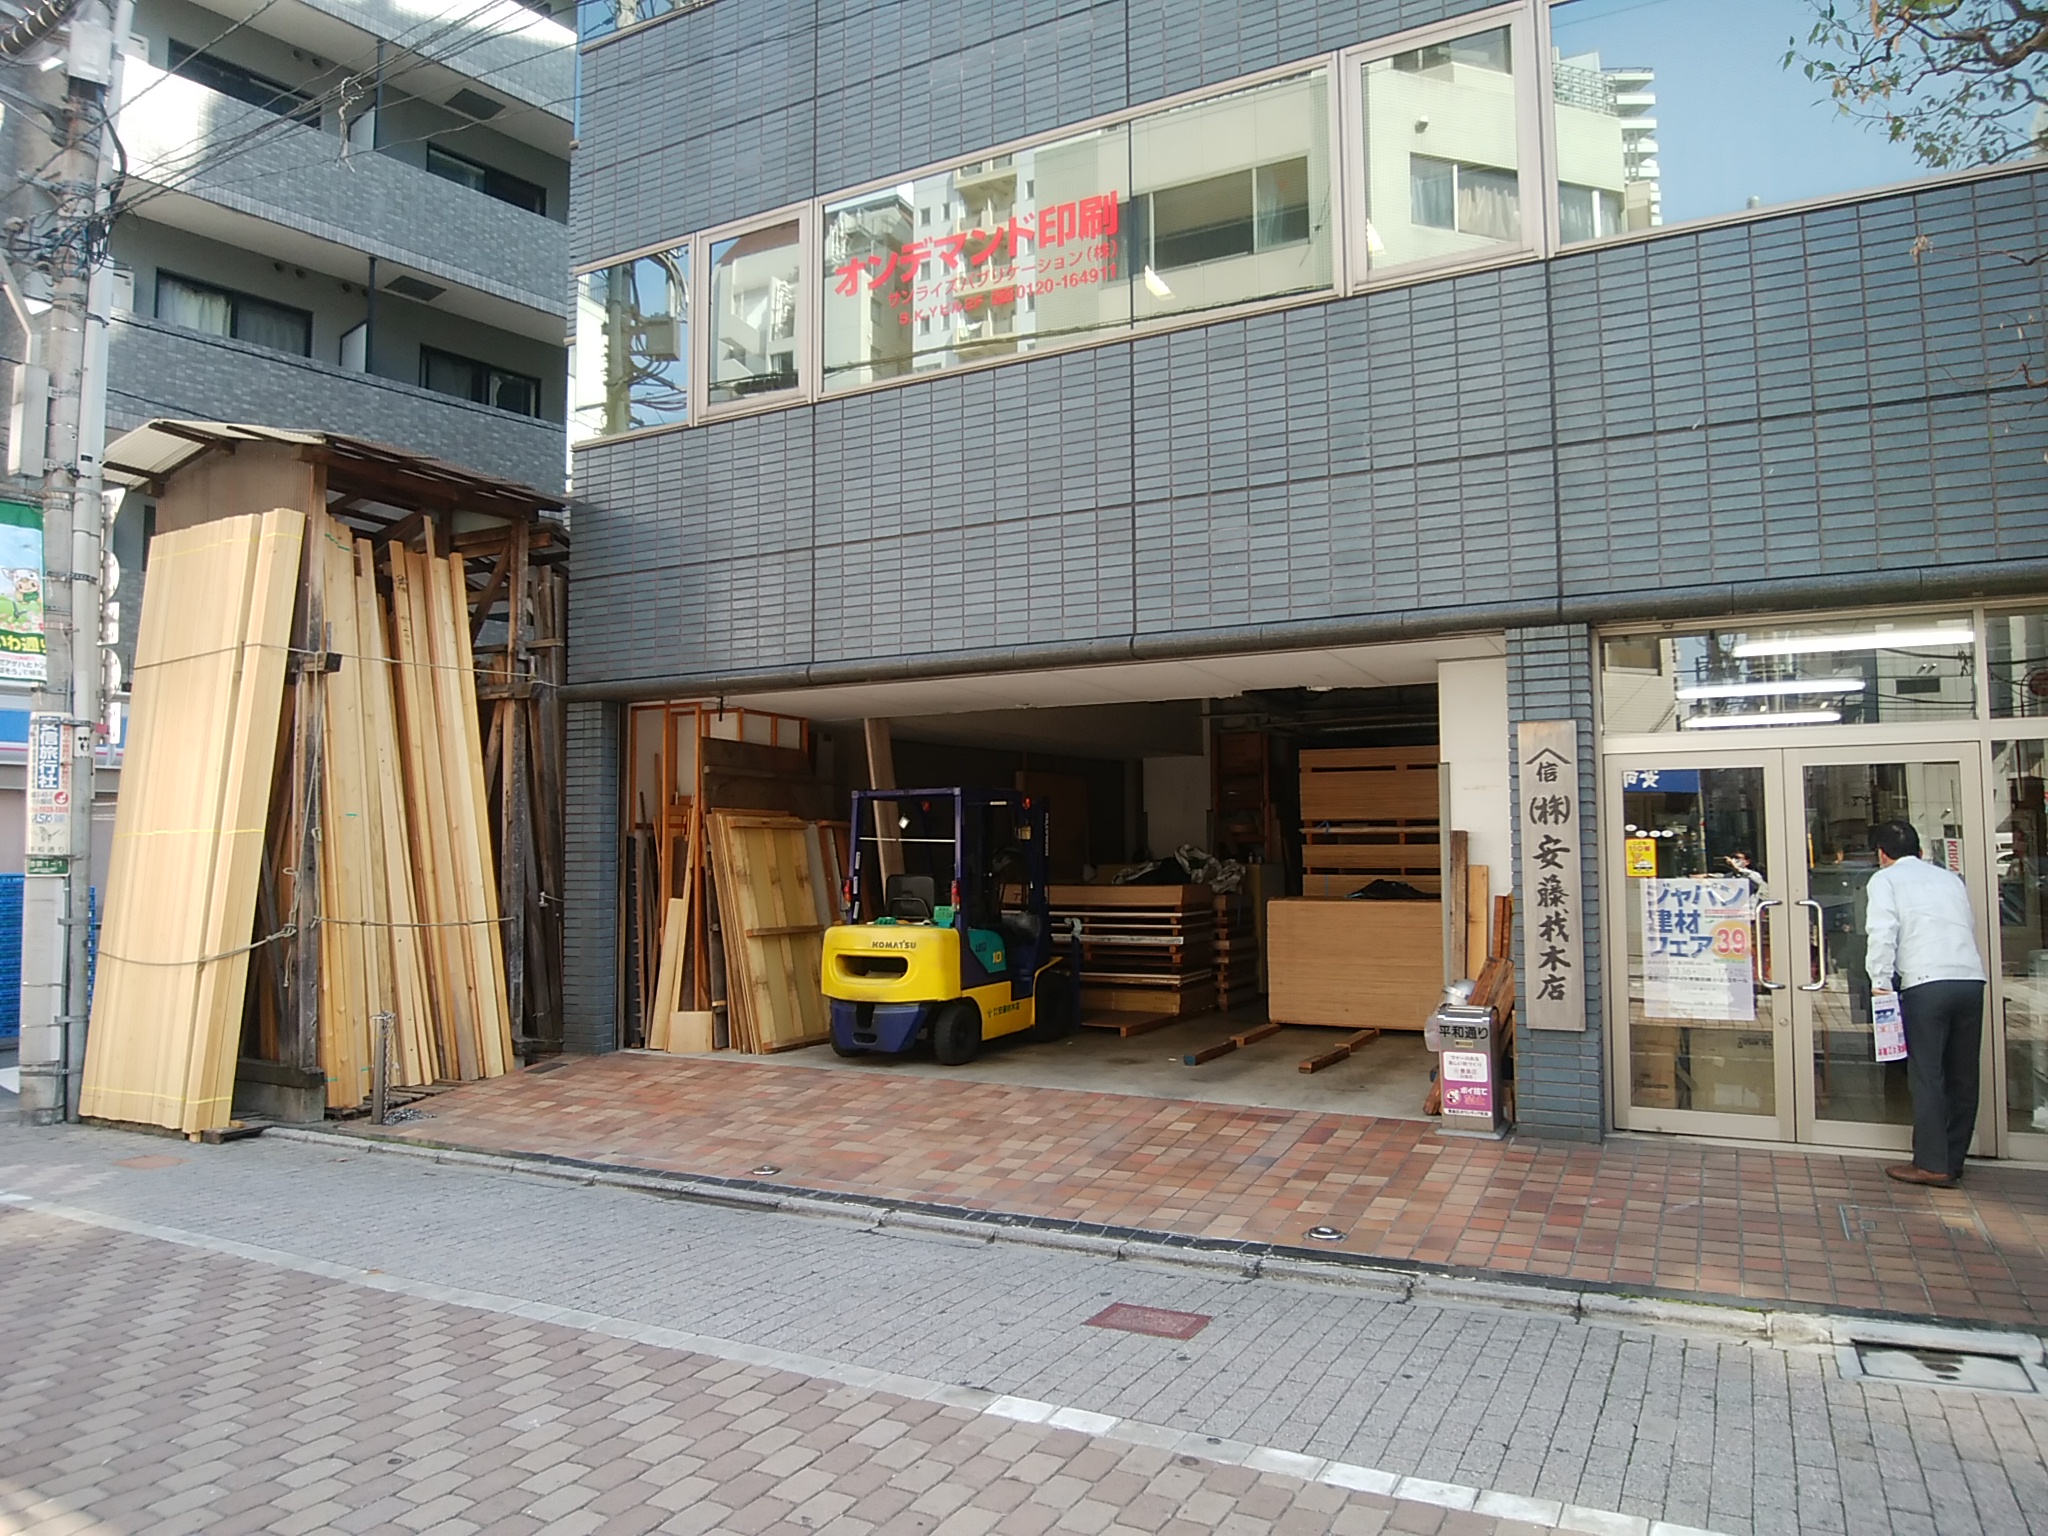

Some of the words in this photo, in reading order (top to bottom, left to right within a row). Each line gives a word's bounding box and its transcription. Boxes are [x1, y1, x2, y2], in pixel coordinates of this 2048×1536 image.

[834, 190, 1119, 297] オンデマンド印刷
[1016, 263, 1118, 300] 0120-164911
[1536, 761, 1559, 782] 信
[1647, 883, 1744, 907] ジャパン
[1647, 909, 1701, 934] 建材
[872, 940, 917, 949] KOMATSU
[1647, 936, 1713, 958] フェア
[1717, 928, 1746, 954] 39
[991, 951, 1003, 963] 10
[1439, 1025, 1488, 1039] 平和通り
[1460, 1086, 1488, 1096] ポイ捨て
